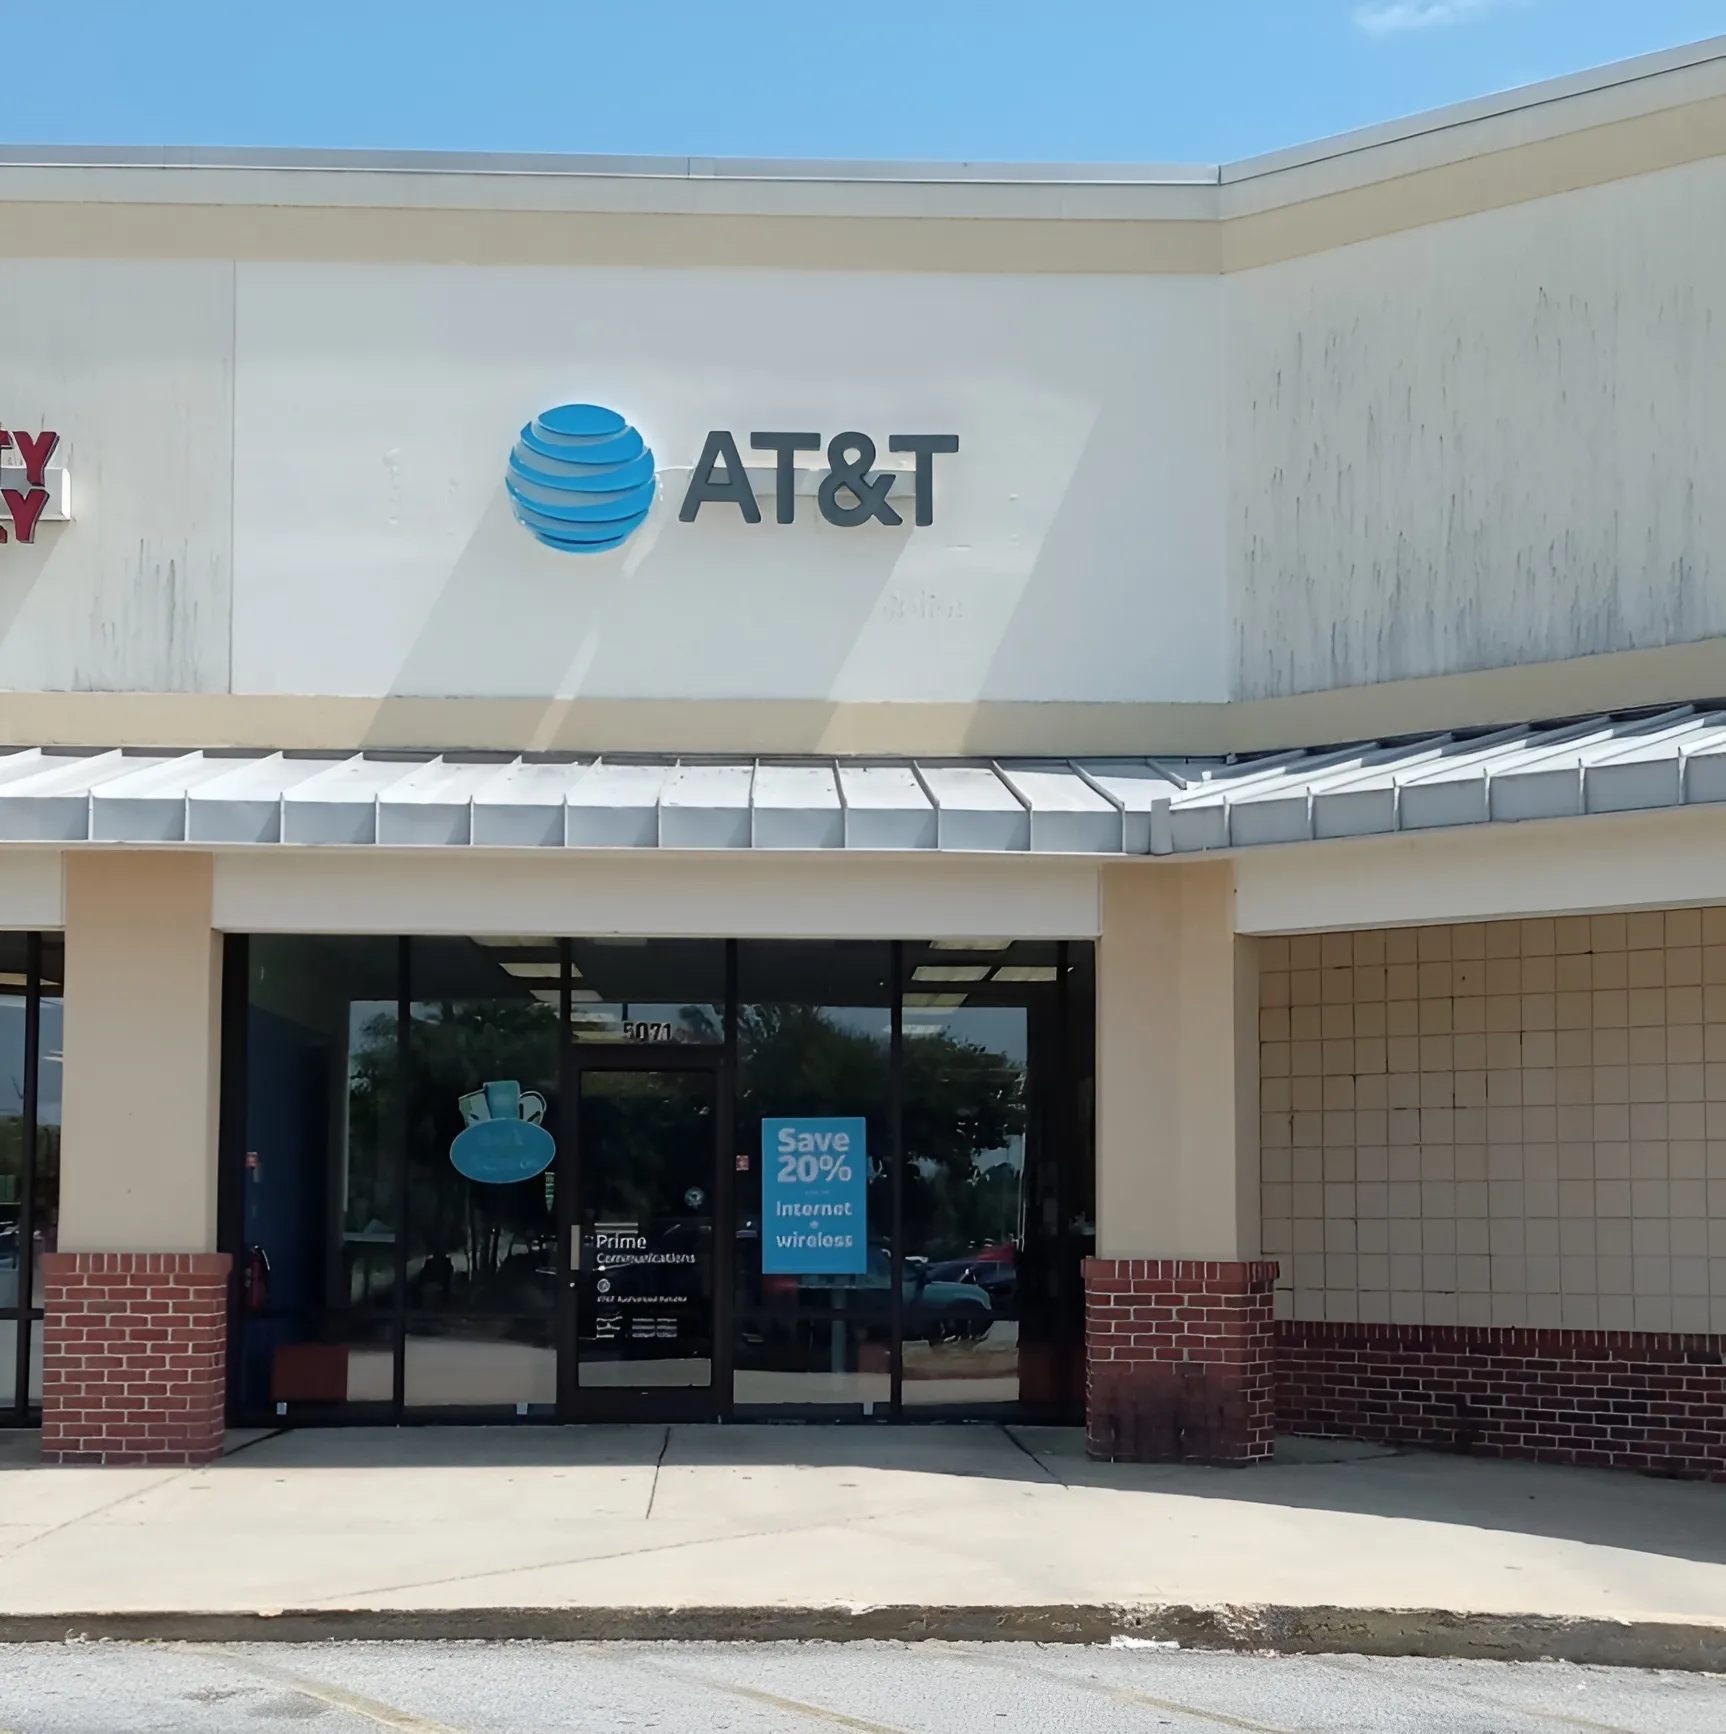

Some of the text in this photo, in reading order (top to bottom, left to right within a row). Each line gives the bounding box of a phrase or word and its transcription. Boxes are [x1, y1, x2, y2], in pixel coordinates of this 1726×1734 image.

[678, 430, 959, 527] AT&T
[0, 488, 50, 544] Y
[623, 1022, 672, 1041] 5071
[777, 1127, 850, 1153] Save
[777, 1154, 852, 1183] 20%
[596, 1234, 647, 1249] Prime
[776, 1231, 853, 1248] wireless
